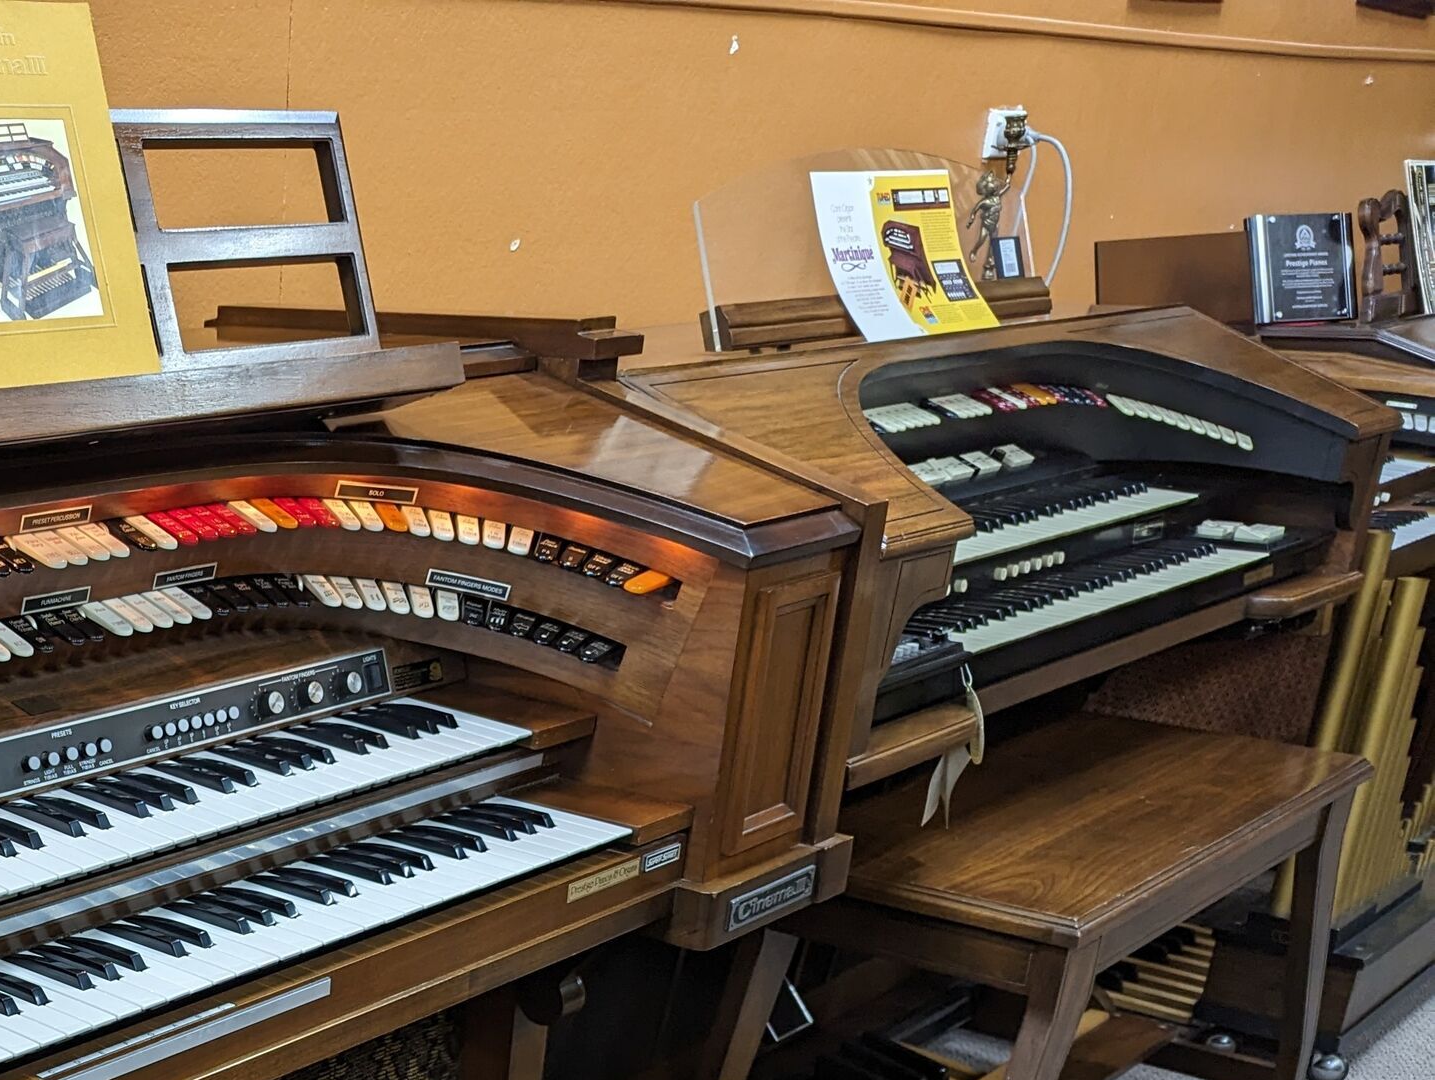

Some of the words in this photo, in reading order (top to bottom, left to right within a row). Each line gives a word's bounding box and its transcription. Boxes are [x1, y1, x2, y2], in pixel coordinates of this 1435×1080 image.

[433, 574, 458, 586] FANTOM
[457, 579, 483, 591] FINGERS
[482, 584, 503, 595] MODES
[51, 728, 73, 739] PRESETS
